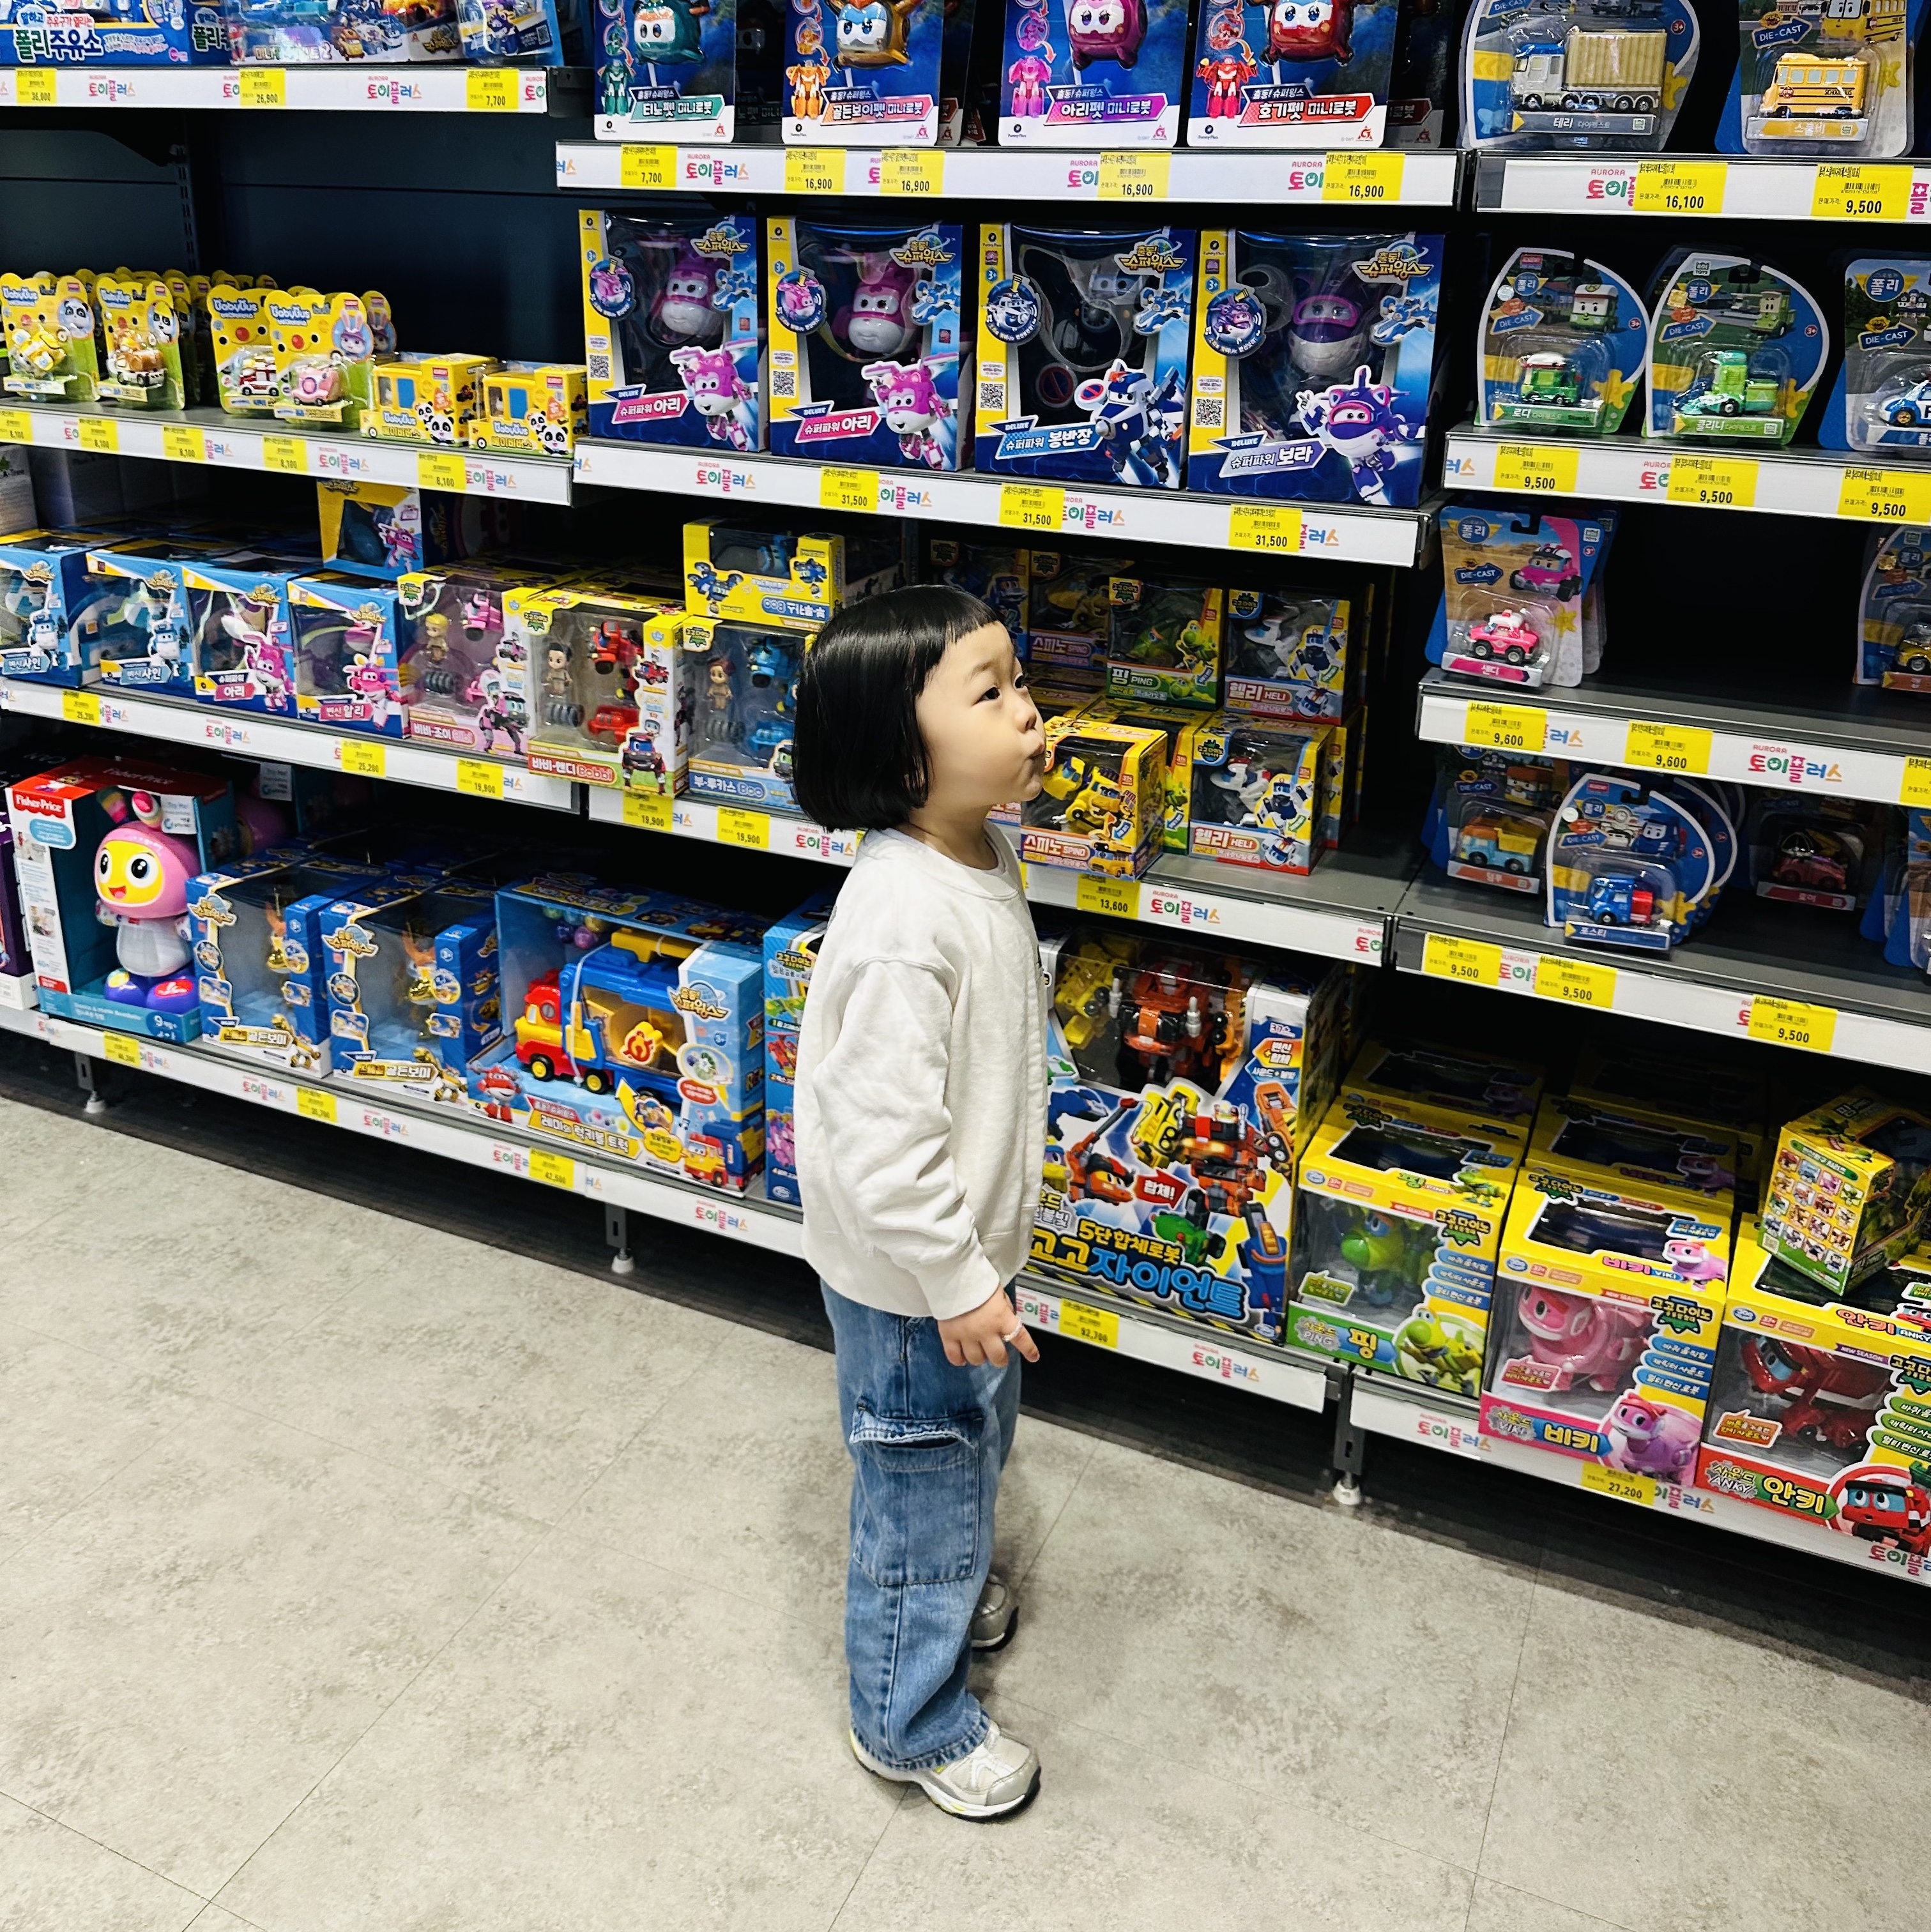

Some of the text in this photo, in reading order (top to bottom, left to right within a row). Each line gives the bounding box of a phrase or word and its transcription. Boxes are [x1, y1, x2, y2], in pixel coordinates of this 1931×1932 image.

[1759, 24, 1803, 42] DIE-CAST
[15, 29, 102, 61] 폴리주유소
[89, 79, 136, 101] 토이플러스
[256, 93, 279, 103] 26,900
[367, 81, 423, 105] 토이플러스
[1253, 88, 1304, 100] 출동! 슈퍼윙스
[485, 96, 506, 107] 7,700
[643, 101, 712, 117] 티노펫 미니로봇
[1061, 100, 1151, 119] 아리펫 미니로봇
[832, 101, 923, 120] 골든보이펫 미니로봇
[1258, 100, 1357, 120] 호기펫 미니로봇
[1553, 118, 1573, 128] 테리
[641, 172, 662, 184] 7,700
[686, 160, 749, 185] 토이플러스
[805, 178, 832, 190] 16,900
[901, 181, 930, 192] 16,900
[1121, 183, 1154, 197] 16,900
[1348, 185, 1384, 199] 16,900
[1665, 195, 1704, 210] 16,100
[1845, 199, 1882, 215] 9,500
[902, 248, 946, 266] 슈퍼윙스
[1138, 245, 1157, 256] 출동!
[1378, 251, 1400, 262] 출동!
[1129, 254, 1177, 272] 슈퍼윙스
[1366, 261, 1423, 279] 슈퍼윙스
[1517, 280, 1536, 292] 폴리
[1689, 285, 1709, 298] 폴리
[1870, 277, 1900, 295] 폴리
[1499, 314, 1533, 328] DIE-CAST
[1669, 322, 1706, 336] DIE-CAST
[1865, 331, 1907, 346] DIE-CAST
[620, 397, 681, 416] 슈퍼파워 아리
[804, 415, 872, 435] 슈퍼파워 아리
[1005, 422, 1030, 431] DELUXE
[1005, 429, 1092, 451] 슈퍼파워 봉반장
[1230, 437, 1258, 447] DELUXE
[1230, 445, 1313, 469] 슈퍼파워 보라
[696, 469, 756, 492] 토이플러스
[1523, 476, 1555, 490] 9,500
[841, 494, 867, 506] 31,500
[1700, 491, 1732, 505] 9,500
[1870, 502, 1907, 517] 9,500
[1023, 512, 1051, 526] 31,500
[1462, 523, 1486, 540] 폴리
[1255, 535, 1288, 547] 31,500
[1460, 570, 1495, 579] DIE-CAST
[142, 666, 161, 680] 샤인
[1112, 667, 1153, 687] 핑 PING
[224, 685, 245, 697] 아리
[1228, 681, 1286, 702] 헬리 HELI
[1493, 732, 1523, 747] 9,600
[1655, 754, 1687, 769] 9,600
[1747, 753, 1843, 784] 토이플러스
[576, 763, 613, 781] Bobbi
[737, 780, 763, 798] Boo
[15, 795, 62, 812] Fisher-Price
[641, 814, 664, 827] 19,900
[735, 832, 761, 845] 19,900
[795, 833, 855, 857] 토이플러스
[1194, 827, 1253, 849] 헬리 HELI
[1100, 898, 1128, 913] 13,600
[1149, 897, 1221, 924] 토이플러스
[1450, 964, 1479, 979] 9,500
[1562, 985, 1592, 1001] 9,500
[1778, 1028, 1810, 1043] 9,500
[607, 1134, 629, 1153] 트럭
[1435, 1209, 1491, 1234] 고고다이노
[1078, 1220, 1182, 1265] 5단 합체로봇
[1030, 1228, 1243, 1318] 고고자이언트
[1603, 1255, 1677, 1281] 비키 VIKI
[1652, 1297, 1713, 1322] 고고다이노
[1304, 1321, 1336, 1336] 사운드
[1837, 1307, 1930, 1343] 안키 ANKY
[1302, 1331, 1332, 1346] PING
[1349, 1327, 1378, 1360] 핑
[1841, 1346, 1883, 1362] NEW SEASON
[1192, 1351, 1260, 1383] 토이플러스
[1679, 1365, 1706, 1378] 사운드
[1901, 1404, 1921, 1415] 바퀴
[1497, 1410, 1532, 1430] 사운드
[1417, 1420, 1493, 1452] 토이플러스
[1499, 1422, 1525, 1436] VIKI
[1544, 1424, 1599, 1453] 비키
[1713, 1464, 1755, 1484] 사운드
[1608, 1480, 1643, 1500] 27,200
[1713, 1477, 1751, 1493] ANKY
[1654, 1484, 1714, 1514] 이플러스
[1763, 1475, 1826, 1514] 안키
[1869, 1546, 1931, 1577] 토이플
